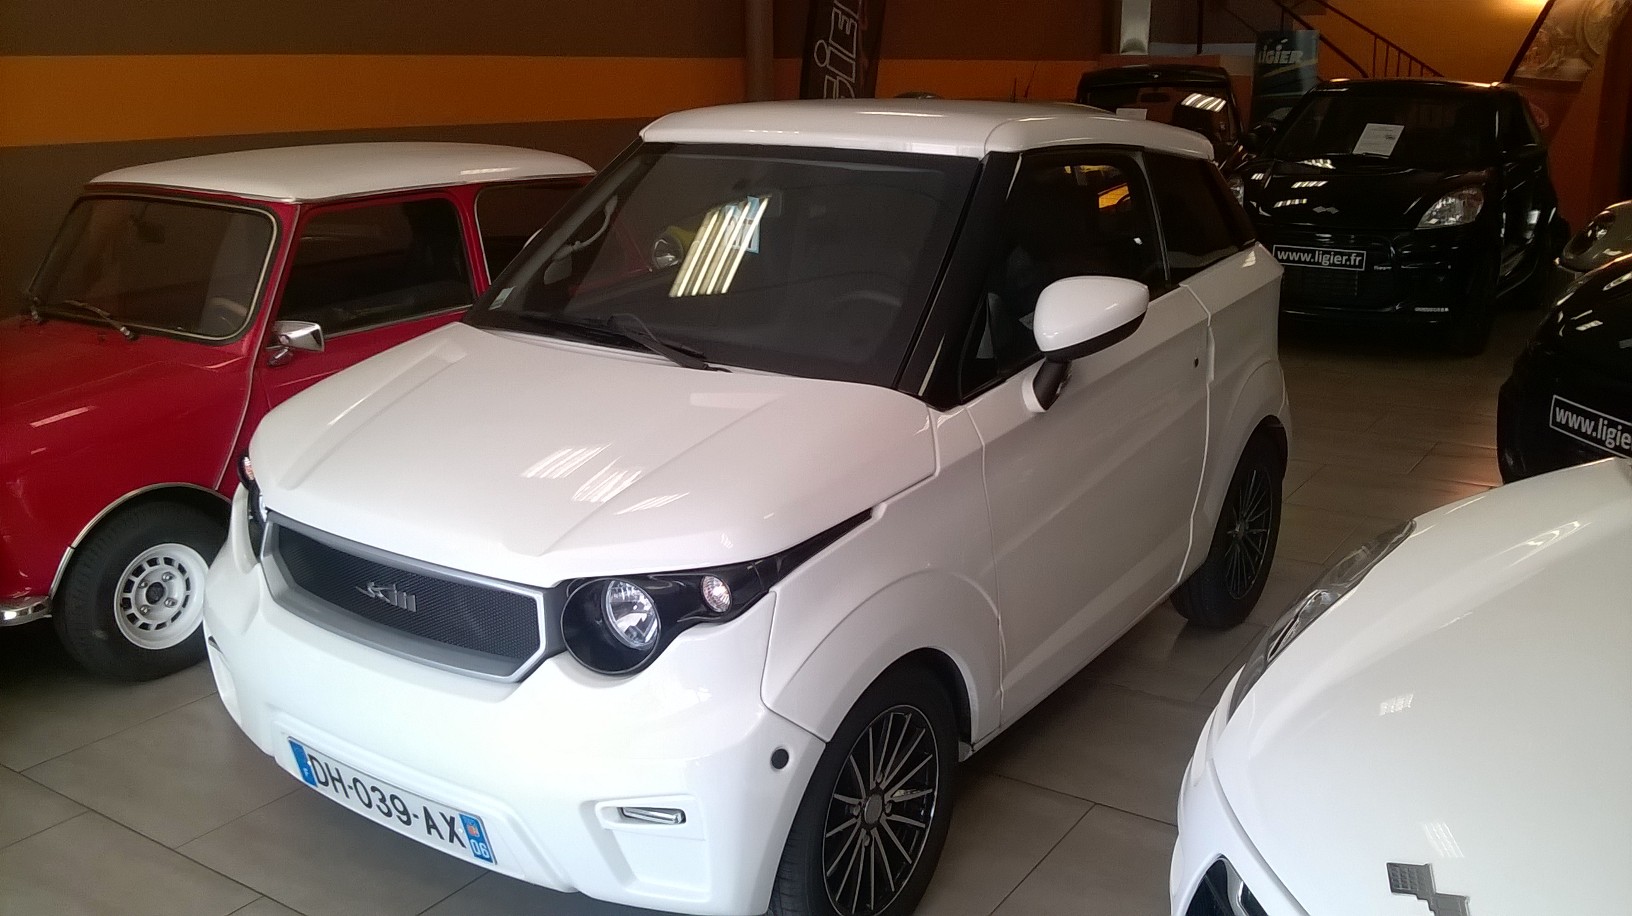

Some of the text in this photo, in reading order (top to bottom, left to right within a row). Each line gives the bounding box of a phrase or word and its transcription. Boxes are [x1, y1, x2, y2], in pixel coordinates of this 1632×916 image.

[1277, 250, 1362, 266] www.ligier.fr
[1555, 406, 1632, 451] www.ligie
[308, 753, 467, 848] DH-039-AX
[470, 838, 490, 858] 06
